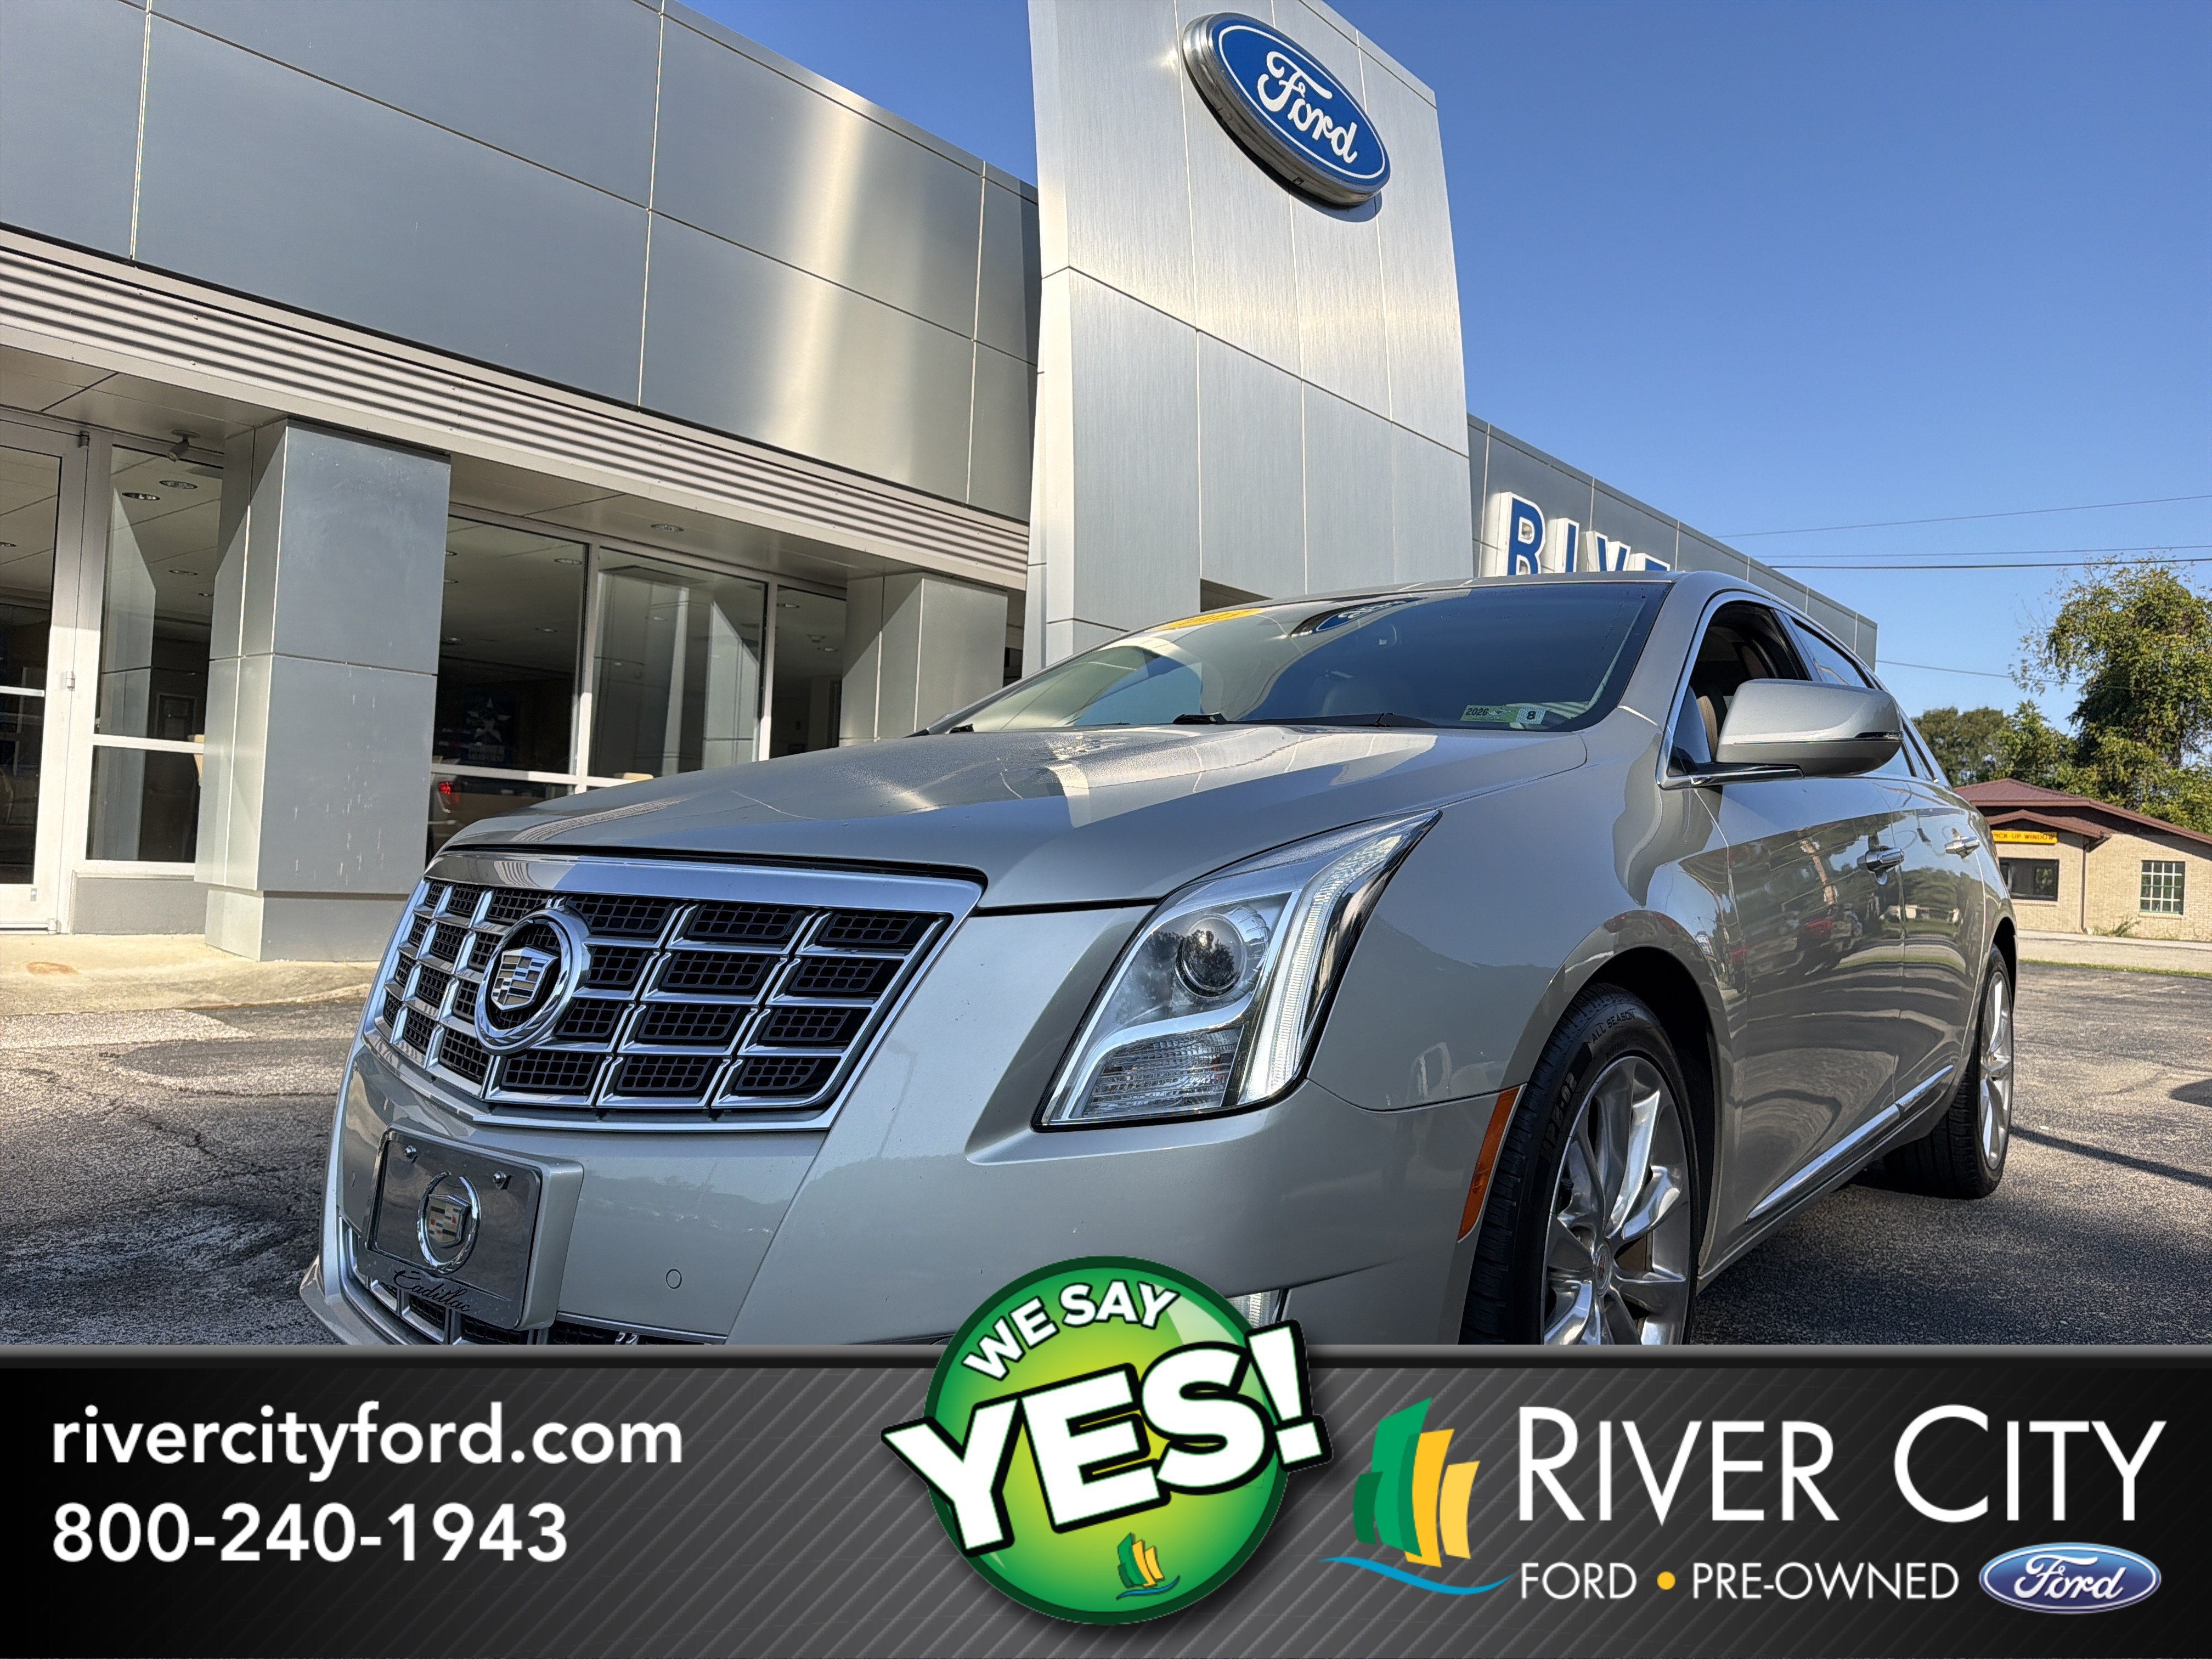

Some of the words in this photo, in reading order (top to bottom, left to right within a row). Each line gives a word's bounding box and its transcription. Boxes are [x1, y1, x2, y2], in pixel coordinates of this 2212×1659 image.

[1257, 50, 1358, 164] Ford
[1505, 492, 1671, 576] RIV
[1466, 708, 1489, 716] 2026
[1526, 710, 1536, 720] 8
[1592, 1025, 1606, 1043] ALL
[1606, 1011, 1635, 1028] SEASON
[393, 1269, 470, 1312] Cadillac
